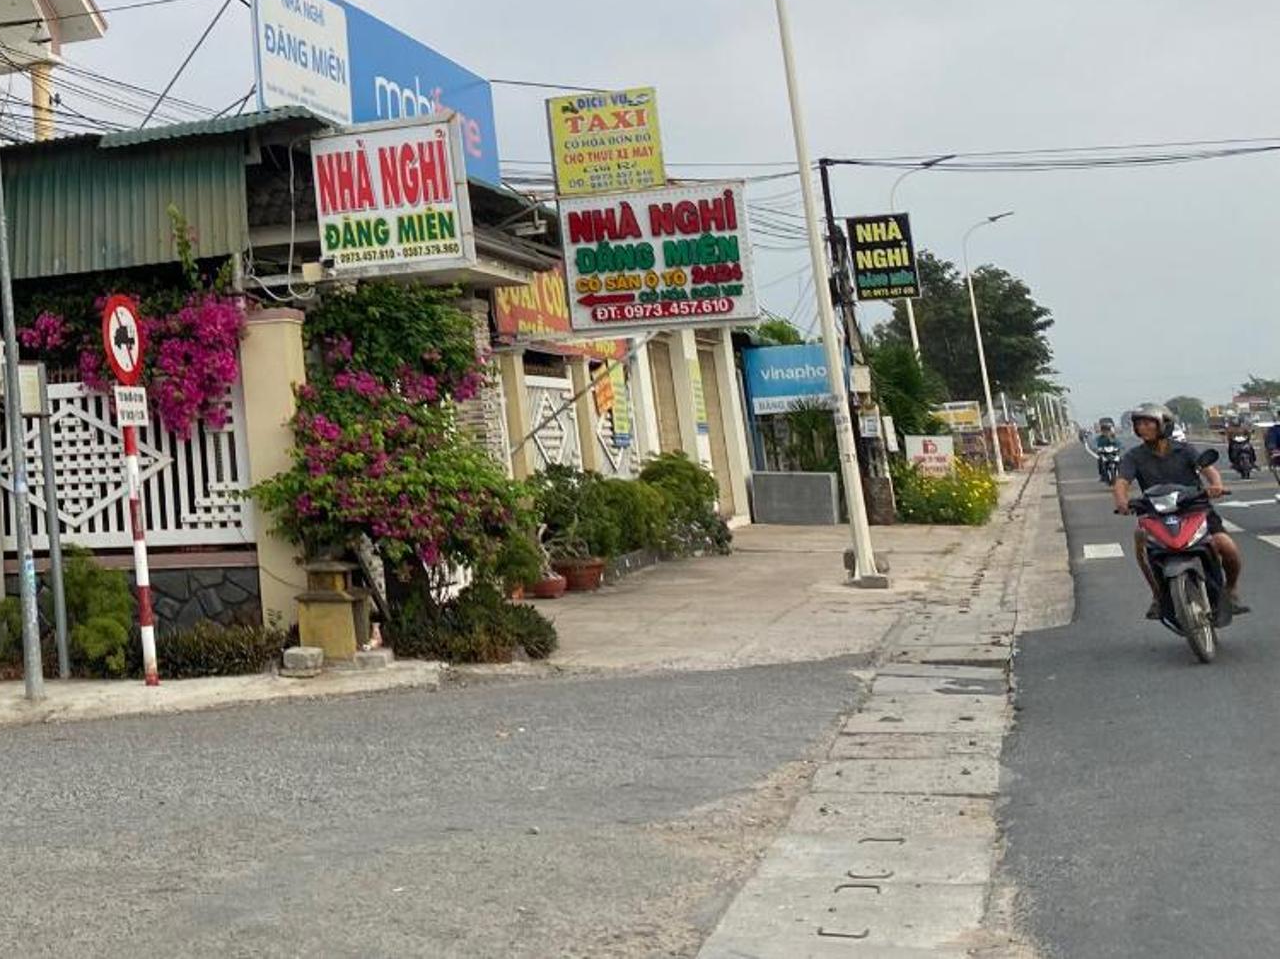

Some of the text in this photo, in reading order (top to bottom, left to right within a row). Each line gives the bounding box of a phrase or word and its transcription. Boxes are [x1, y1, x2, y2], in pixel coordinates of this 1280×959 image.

[564, 109, 647, 134] TAXI
[315, 129, 453, 216] NHÀ NGHỈ
[325, 207, 455, 251] ĐĂNG MIÊN
[567, 189, 738, 243] NHÀ NGHỈ
[855, 217, 903, 243] NHÀ
[662, 232, 740, 267] MIÊN
[855, 240, 910, 270] NGHỈ
[596, 299, 729, 320] ĐT: 0973.457.610
[761, 363, 828, 381] vinapho
